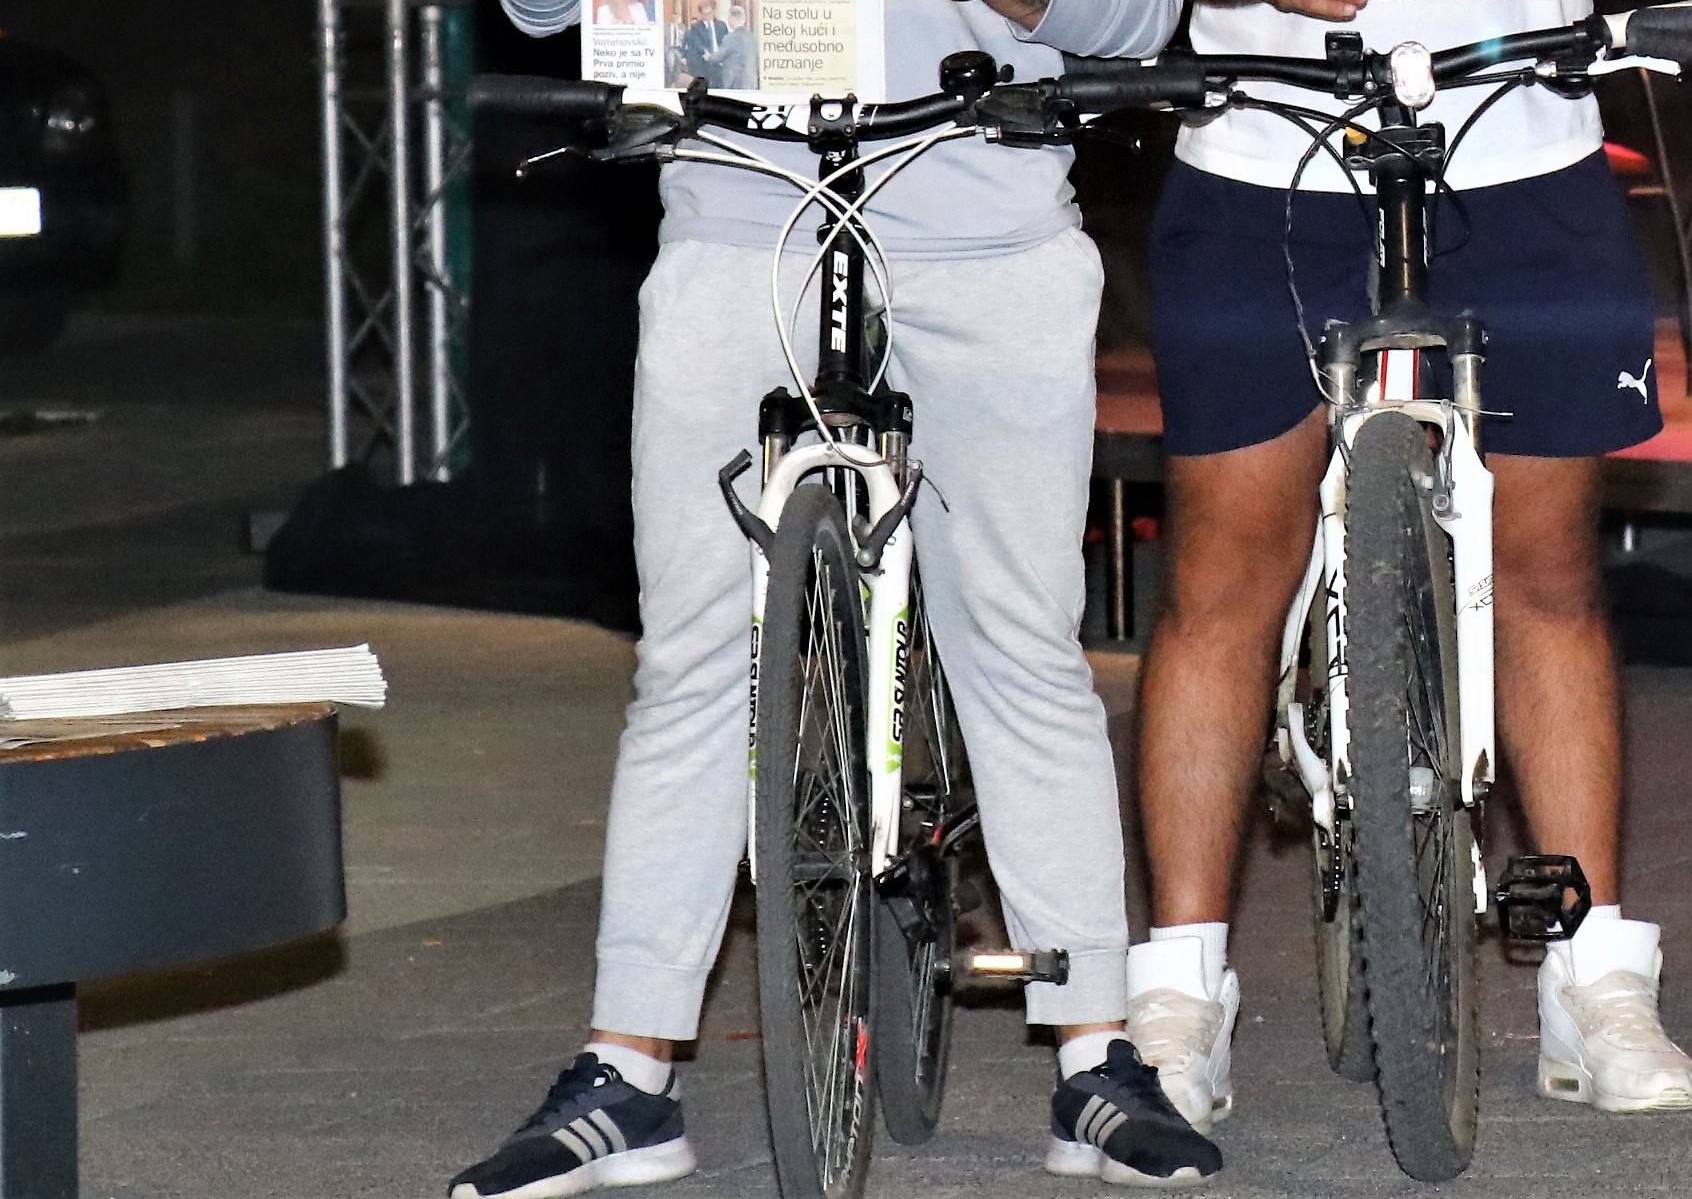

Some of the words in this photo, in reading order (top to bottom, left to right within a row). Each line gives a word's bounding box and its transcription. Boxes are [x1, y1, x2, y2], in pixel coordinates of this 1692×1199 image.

[763, 7, 781, 19] Na
[786, 7, 818, 19] stolu
[824, 10, 831, 19] u
[763, 23, 796, 39] Beloj
[801, 23, 827, 35] kući
[764, 40, 843, 52] međusobno
[619, 50, 627, 58] je
[593, 59, 613, 67] Prva
[764, 56, 823, 72] priznanje
[594, 71, 617, 79] poziv,
[630, 71, 646, 80] nije
